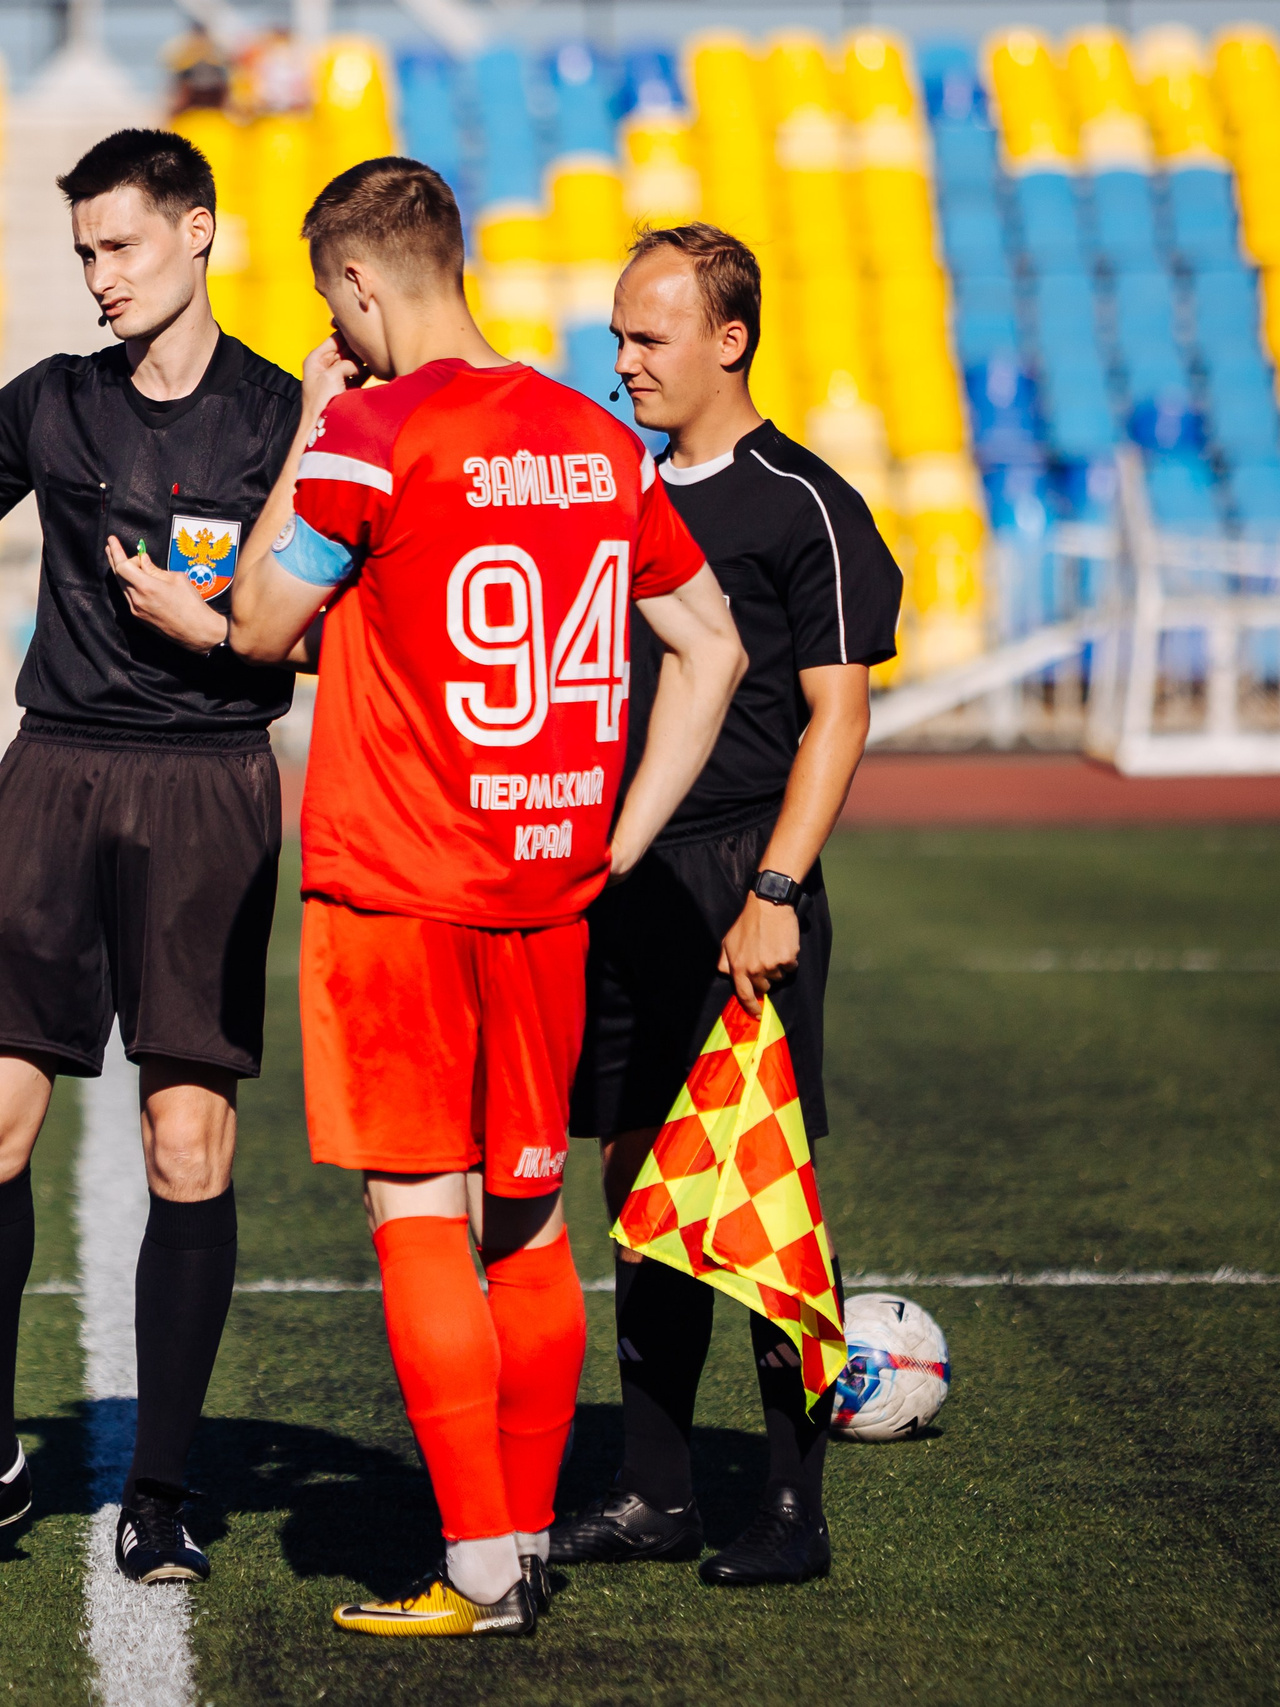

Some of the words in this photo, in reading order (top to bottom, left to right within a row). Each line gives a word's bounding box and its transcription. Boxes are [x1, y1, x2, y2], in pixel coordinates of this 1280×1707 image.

[463, 449, 617, 509] ЗАЙЦЕВ
[445, 539, 630, 747] 94
[470, 765, 604, 810] ПЕРМСКИЙ
[514, 818, 573, 861] КРАЙ
[472, 1614, 524, 1632] MERCURIAL
